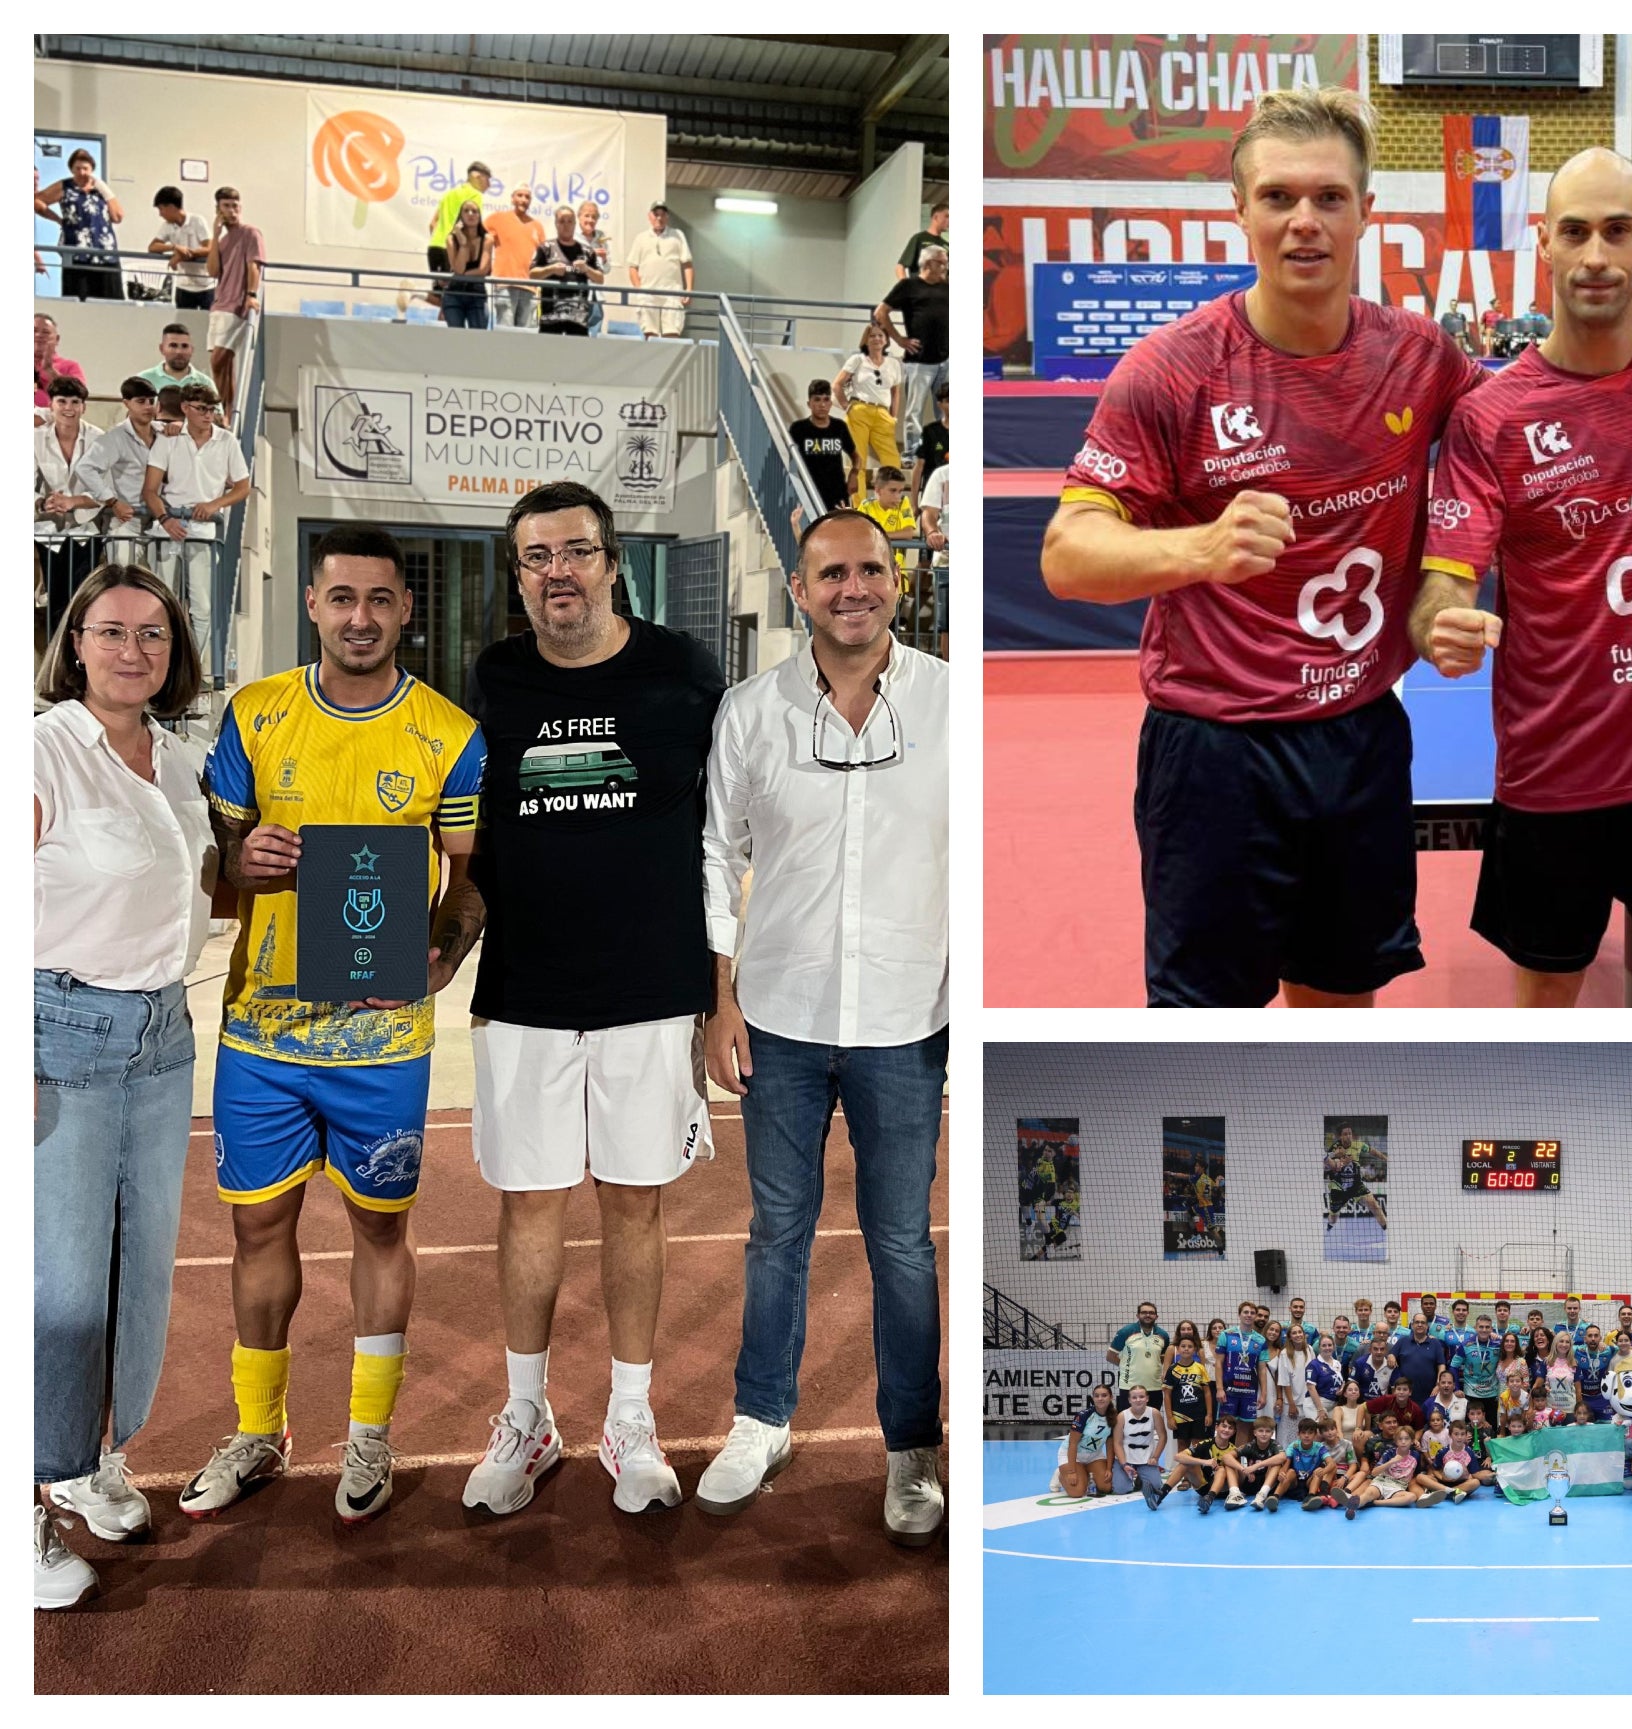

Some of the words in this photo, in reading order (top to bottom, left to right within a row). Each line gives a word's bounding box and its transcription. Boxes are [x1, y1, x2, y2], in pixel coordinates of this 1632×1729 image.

[990, 48, 1150, 110] НАША
[425, 386, 604, 418] PATRONATO
[426, 412, 604, 445] DEPORTIVO
[425, 442, 603, 473] MUNICIPAL
[1204, 443, 1287, 474] Diputación
[1521, 453, 1595, 487] Diputación
[447, 474, 509, 494] PALMA
[1290, 504, 1304, 520] A
[1308, 475, 1408, 517] GARROCHA
[1590, 507, 1613, 525] LA
[537, 720, 563, 739] AS
[567, 717, 617, 737] FREE
[519, 799, 539, 816] AS
[543, 795, 578, 813] YOU
[583, 792, 637, 810] WANT
[350, 970, 376, 980] RFAF
[682, 1122, 698, 1160] FILA
[1471, 1142, 1494, 1157] 24
[1535, 1142, 1557, 1158] 22
[1466, 1161, 1493, 1169] LOCAL
[1530, 1161, 1556, 1169] VISITANTE
[1507, 1151, 1515, 1162] 2
[1470, 1173, 1479, 1184] 0
[1487, 1172, 1535, 1187] 60:00
[1551, 1173, 1559, 1184] 0
